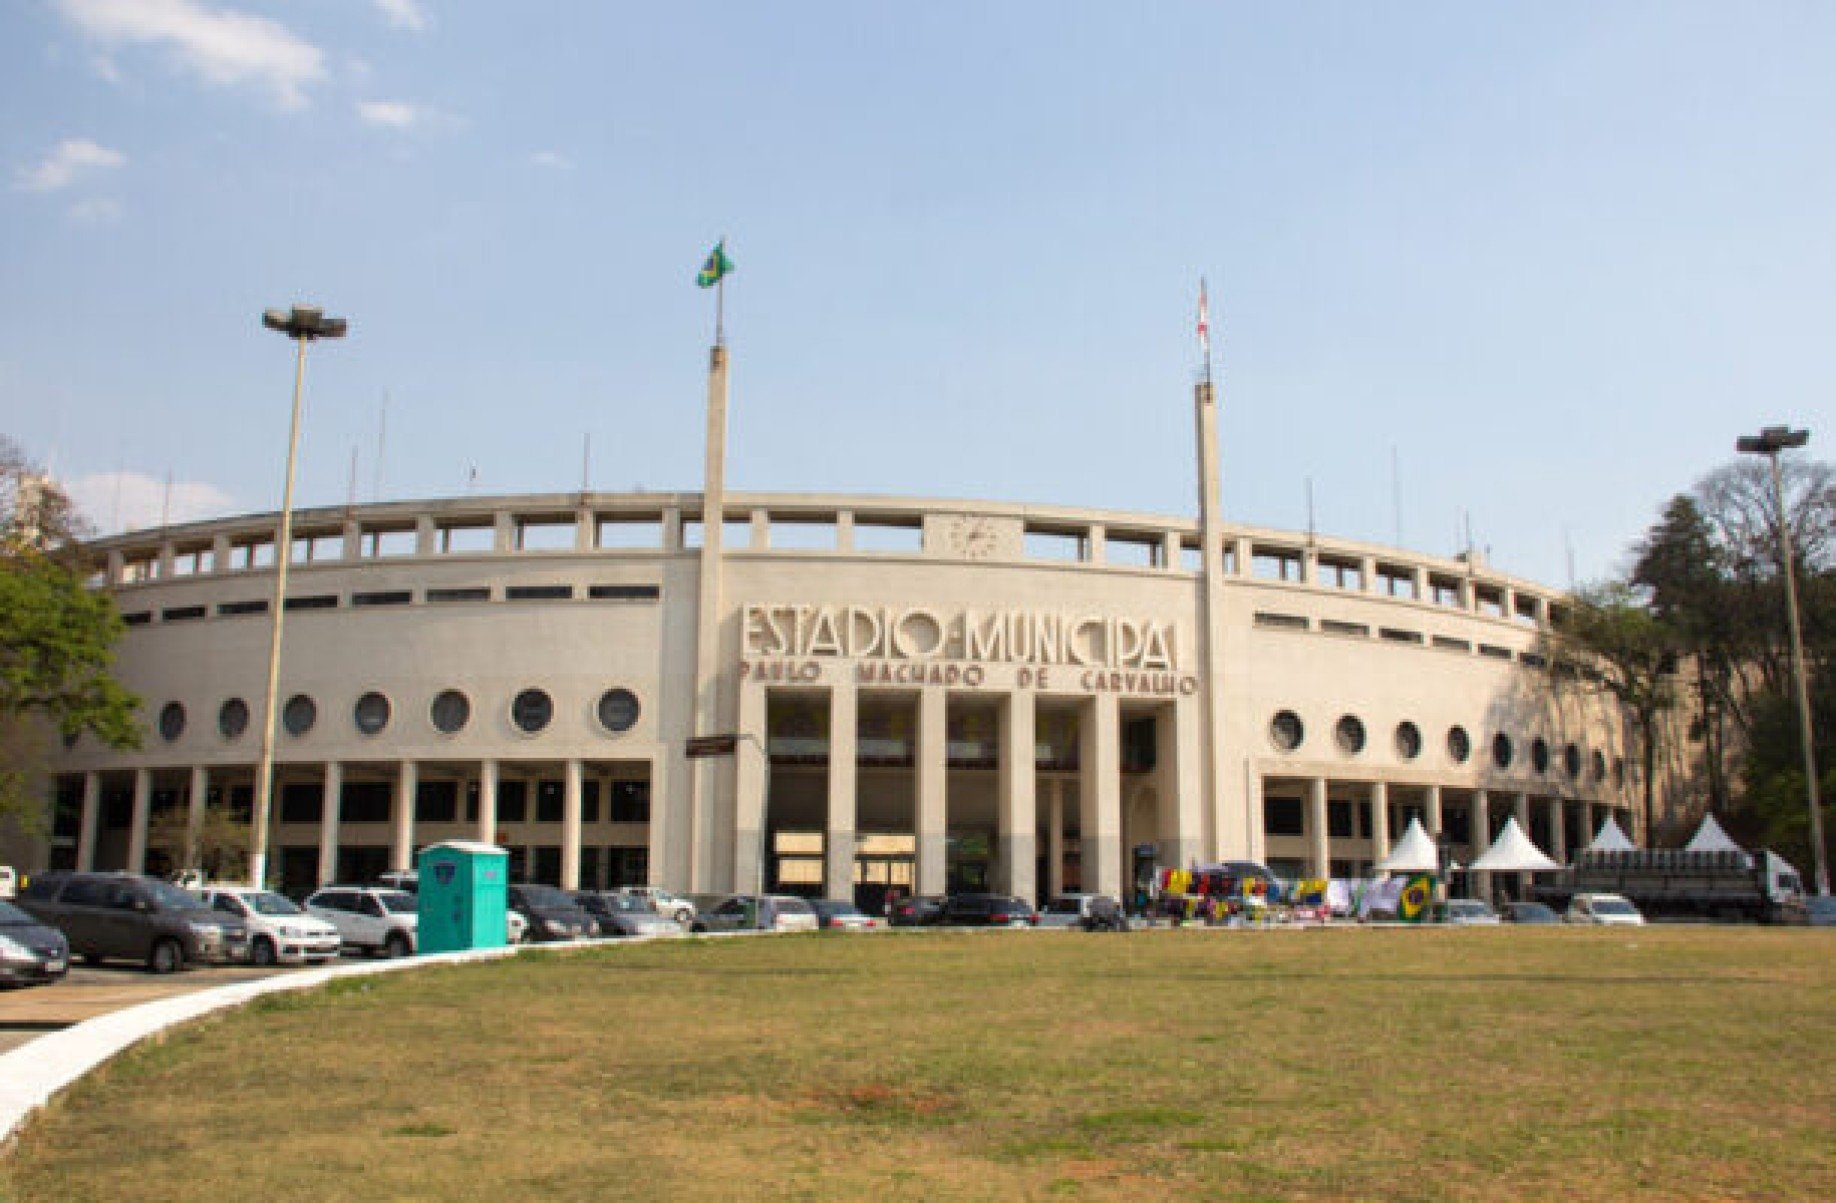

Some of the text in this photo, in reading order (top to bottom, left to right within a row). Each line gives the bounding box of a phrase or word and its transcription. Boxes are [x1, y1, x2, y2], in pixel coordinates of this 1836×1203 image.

[742, 604, 945, 658] ESTADIO
[739, 660, 1197, 696] PAULO MACHADO DE CARVALHO
